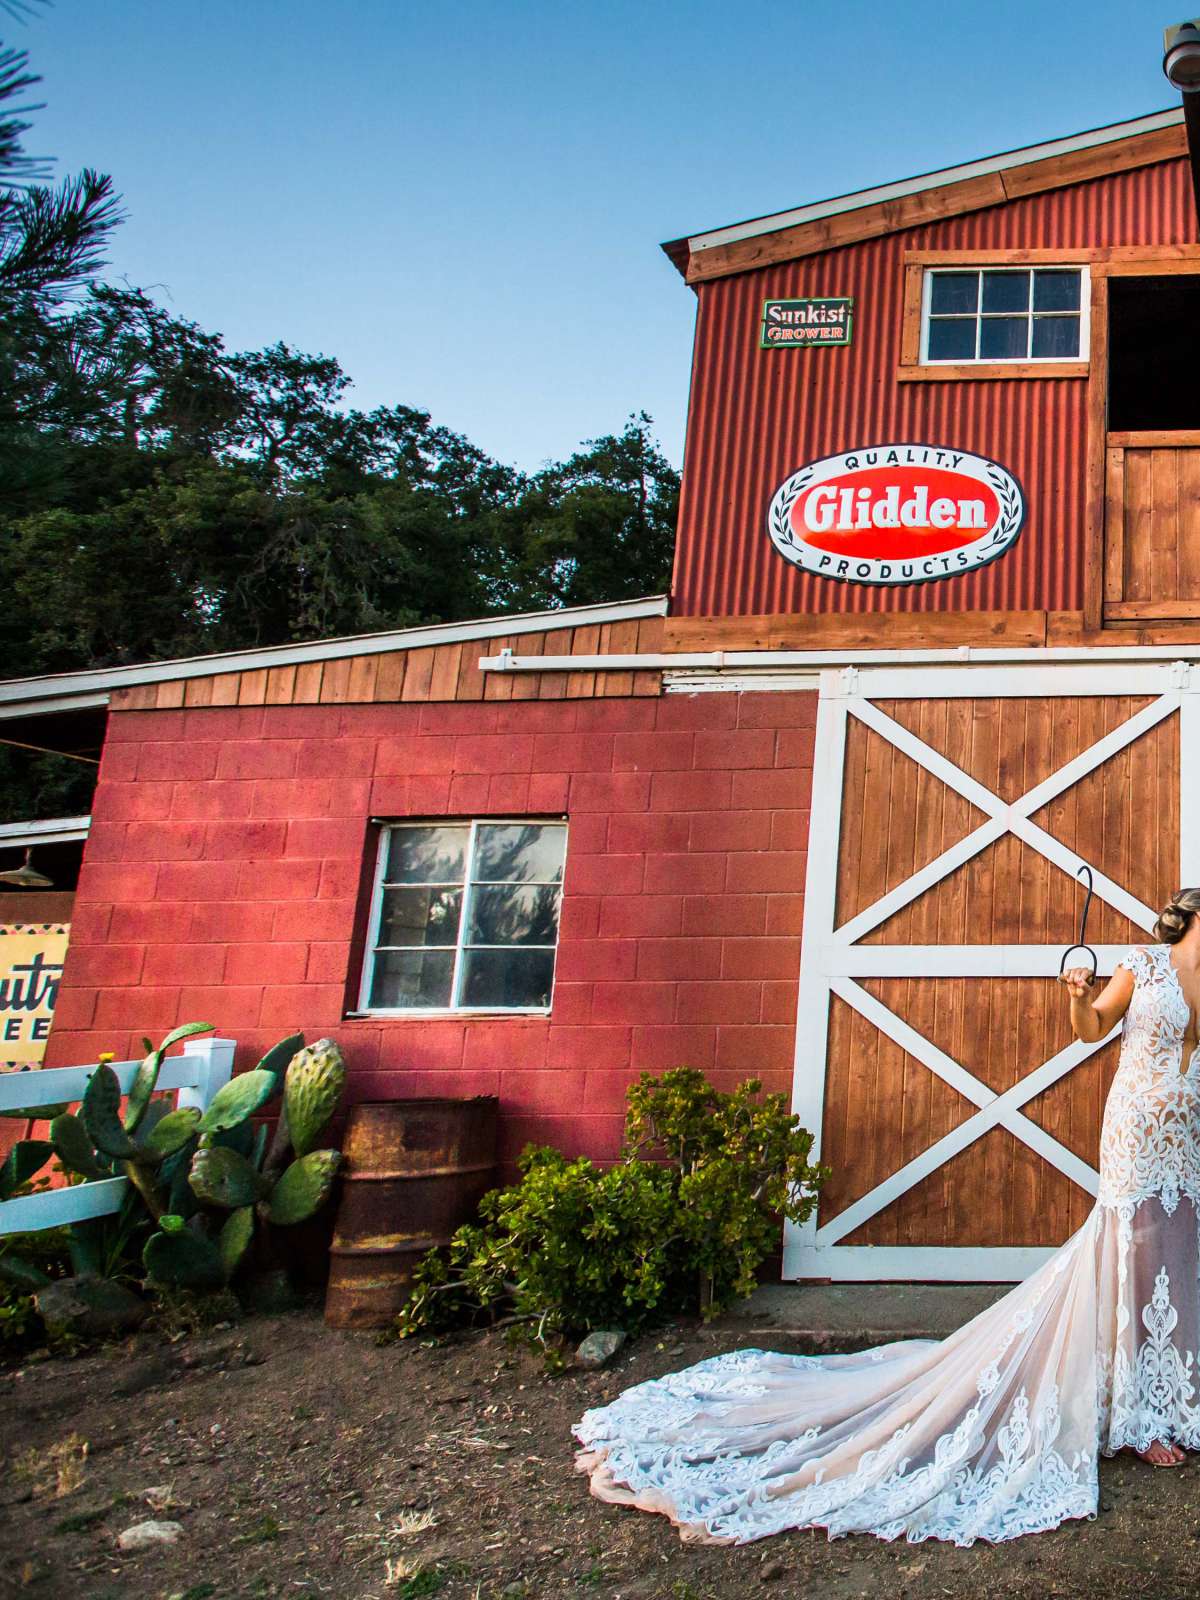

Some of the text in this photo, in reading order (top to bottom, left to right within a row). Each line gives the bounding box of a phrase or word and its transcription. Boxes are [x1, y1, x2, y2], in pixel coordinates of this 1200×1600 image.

[768, 304, 846, 325] Sunkist
[768, 327, 844, 340] GROWER
[844, 449, 964, 469] QUALITY
[804, 485, 988, 533] Glidden
[819, 551, 968, 579] PRODUCTS
